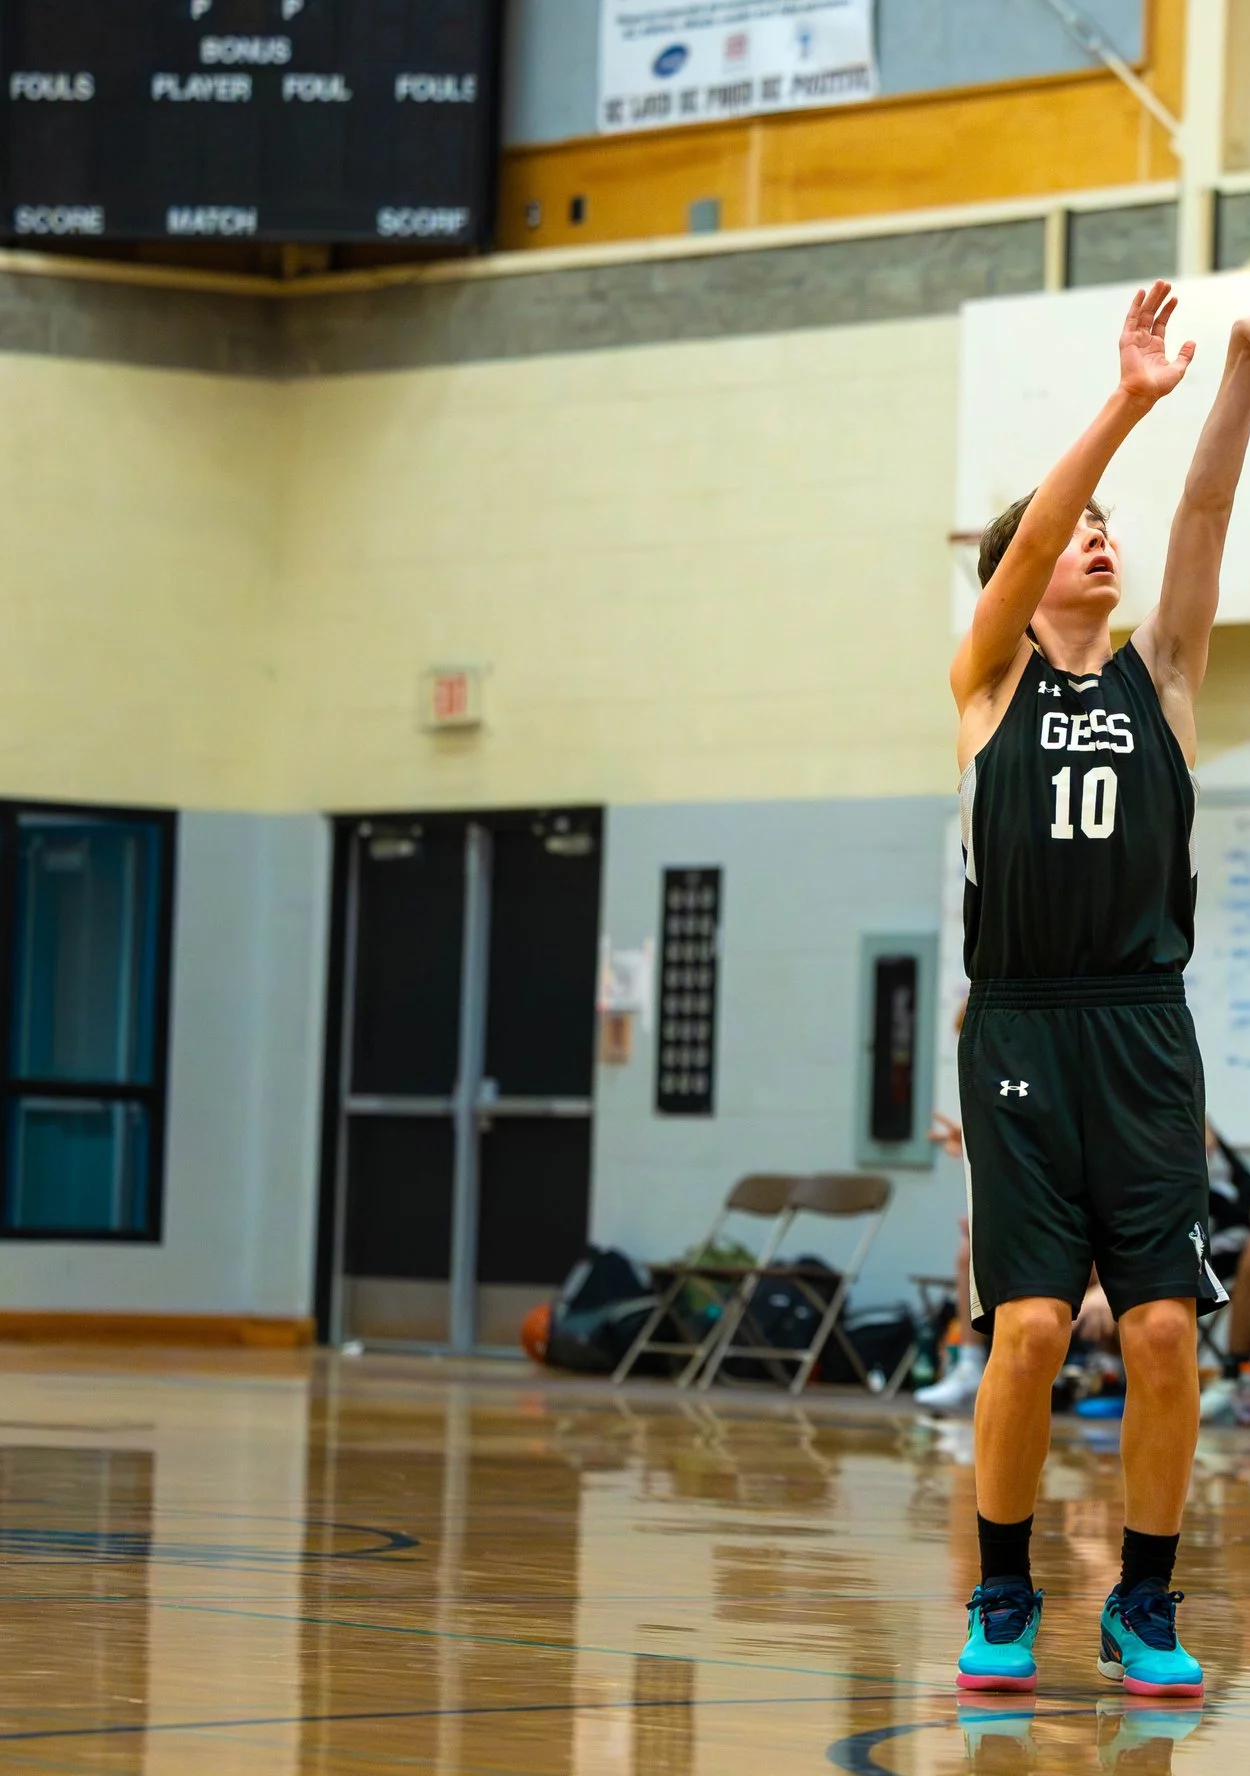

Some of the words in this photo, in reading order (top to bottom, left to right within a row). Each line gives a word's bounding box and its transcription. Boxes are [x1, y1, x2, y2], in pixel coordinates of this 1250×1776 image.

[200, 35, 292, 65] BONUS
[10, 71, 95, 101] FOULS
[151, 72, 252, 102] PLAYER
[283, 72, 352, 102] FOUL
[14, 205, 104, 235] SCORE
[167, 205, 257, 235] MATCH
[1040, 708, 1135, 754] GESS
[1050, 766, 1118, 840] 10
